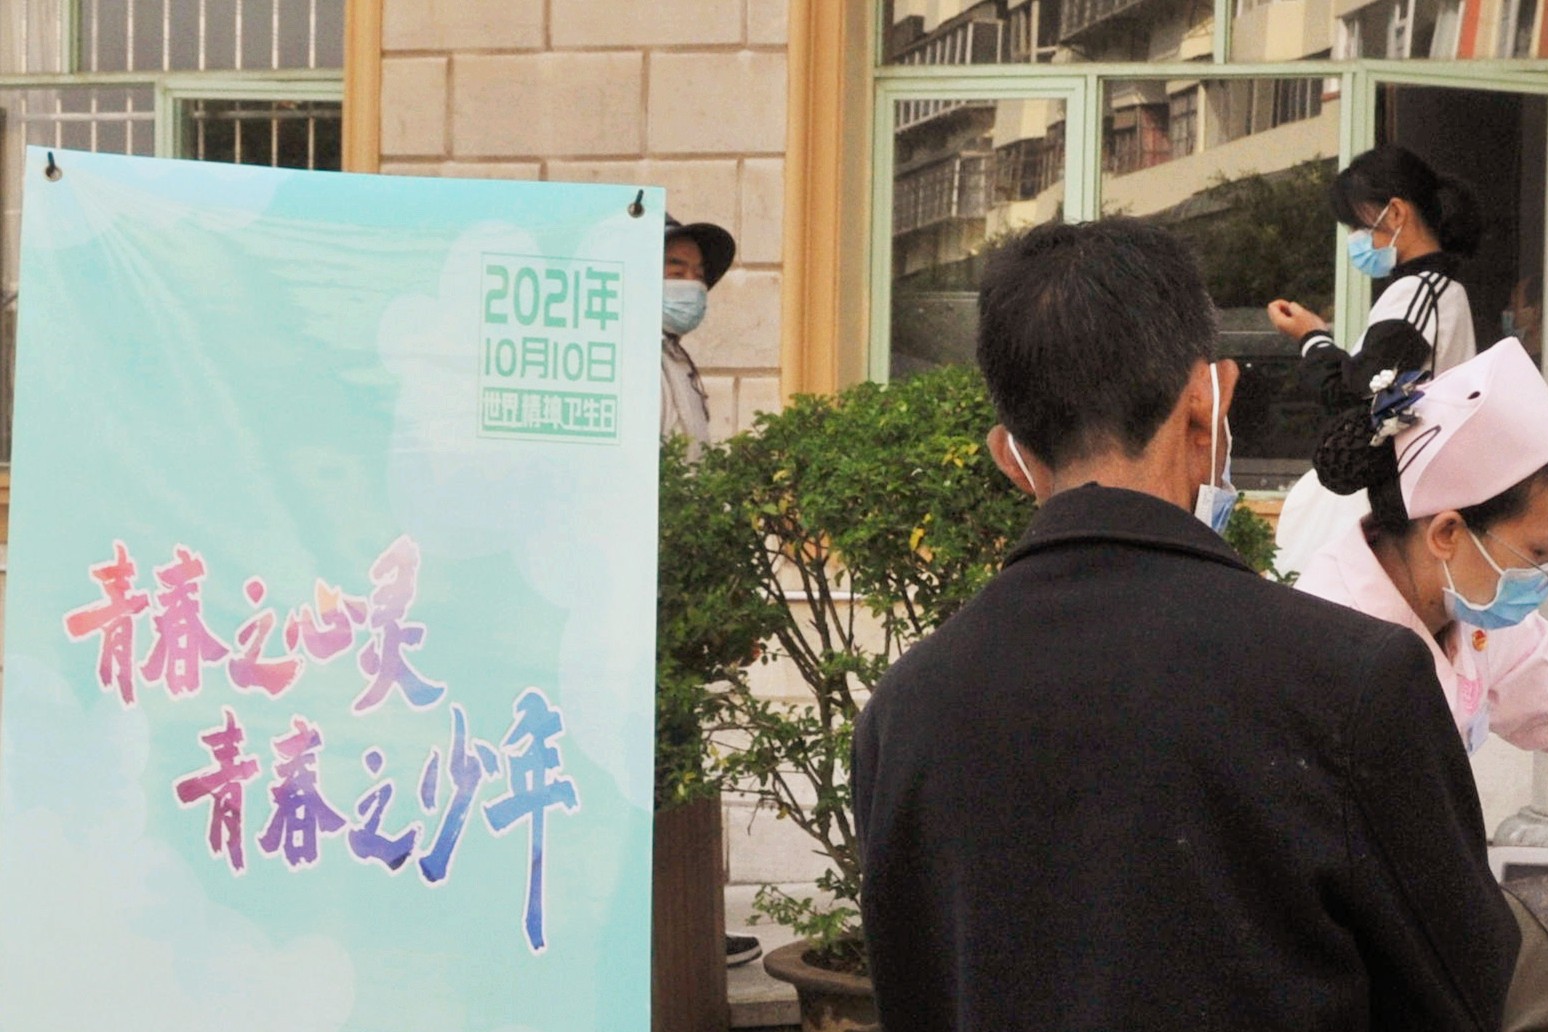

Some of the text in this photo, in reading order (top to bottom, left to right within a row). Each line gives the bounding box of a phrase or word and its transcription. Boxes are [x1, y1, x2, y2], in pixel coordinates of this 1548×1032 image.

[484, 264, 620, 331] 2021年
[484, 337, 616, 383] 10月10日
[483, 391, 616, 432] 世界精神卫生日
[64, 534, 447, 713] 青春之心灵
[174, 687, 580, 955] 青春之少年
